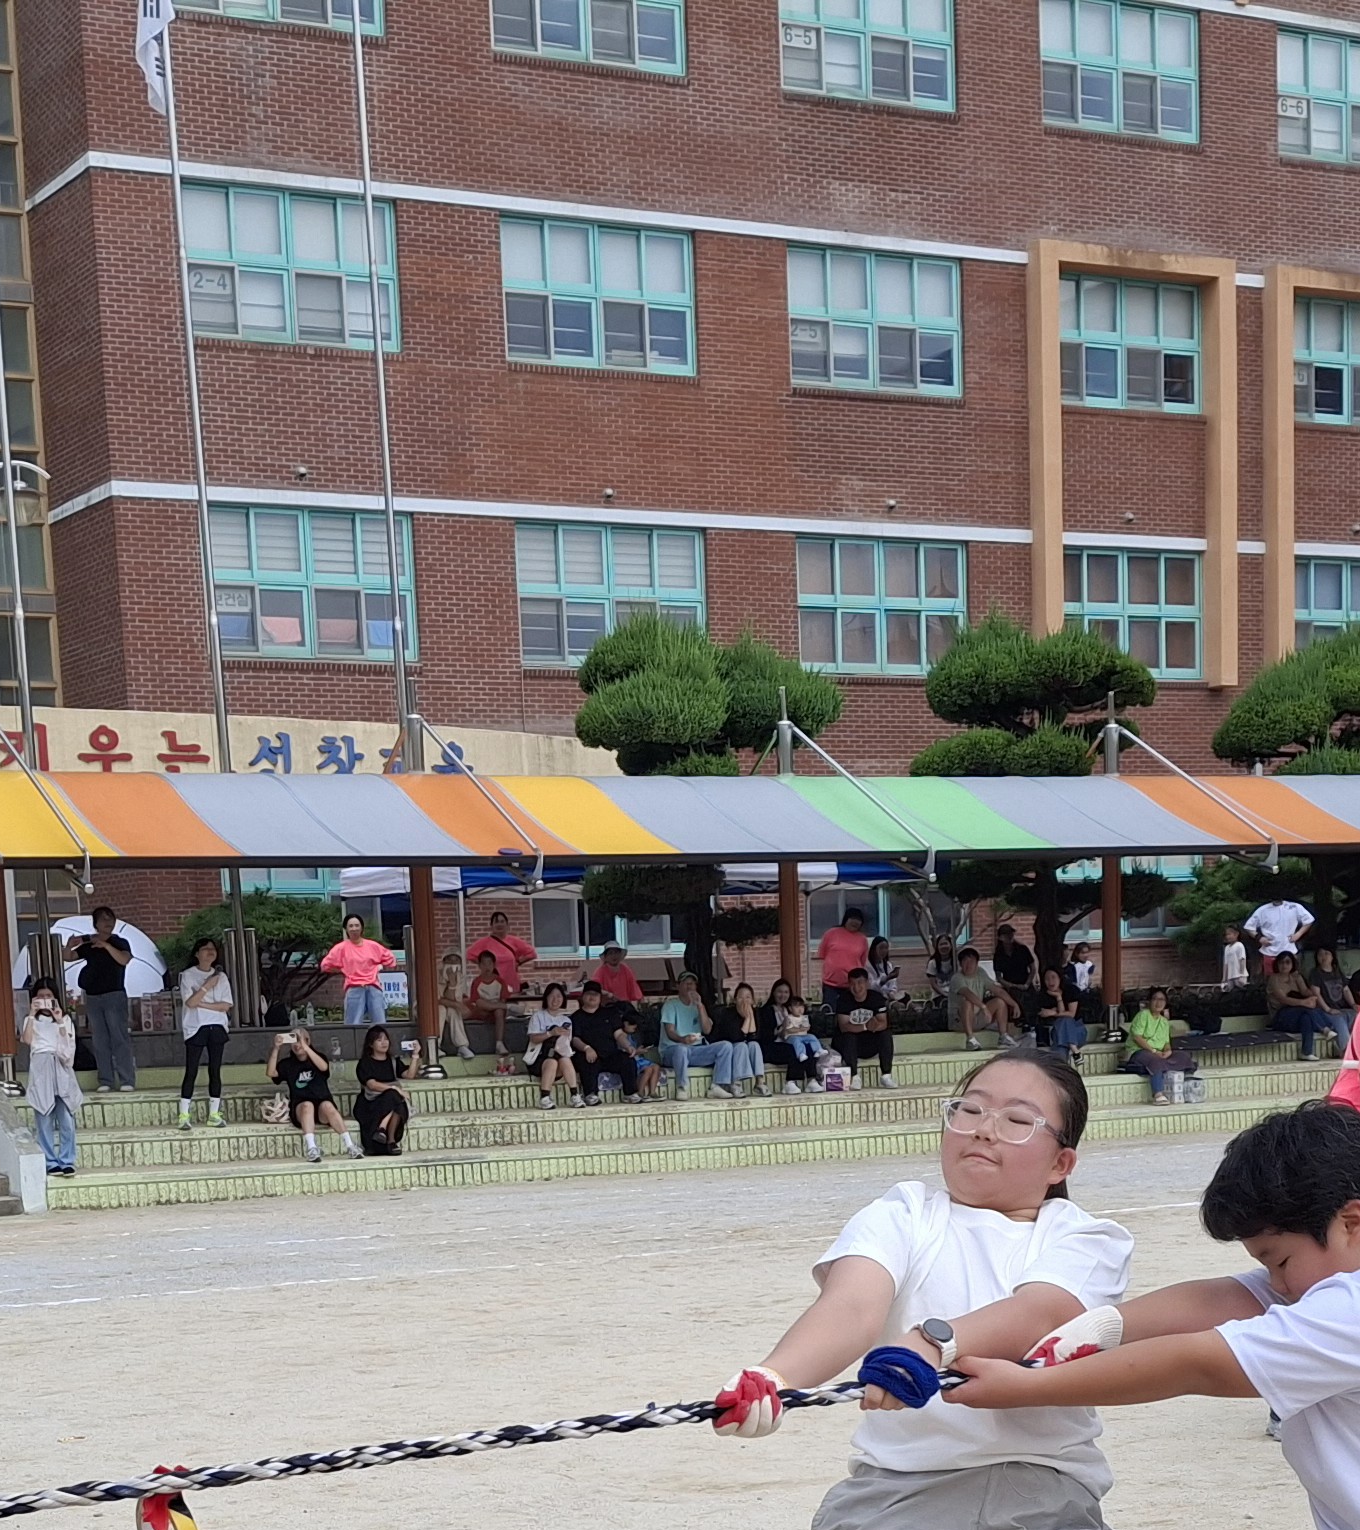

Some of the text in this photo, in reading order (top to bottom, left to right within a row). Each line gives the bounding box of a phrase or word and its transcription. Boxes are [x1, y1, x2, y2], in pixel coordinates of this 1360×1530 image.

[784, 26, 812, 46] 6-5
[1281, 97, 1304, 116] 6-6
[193, 271, 228, 291] 2-4
[790, 323, 818, 339] 2-5
